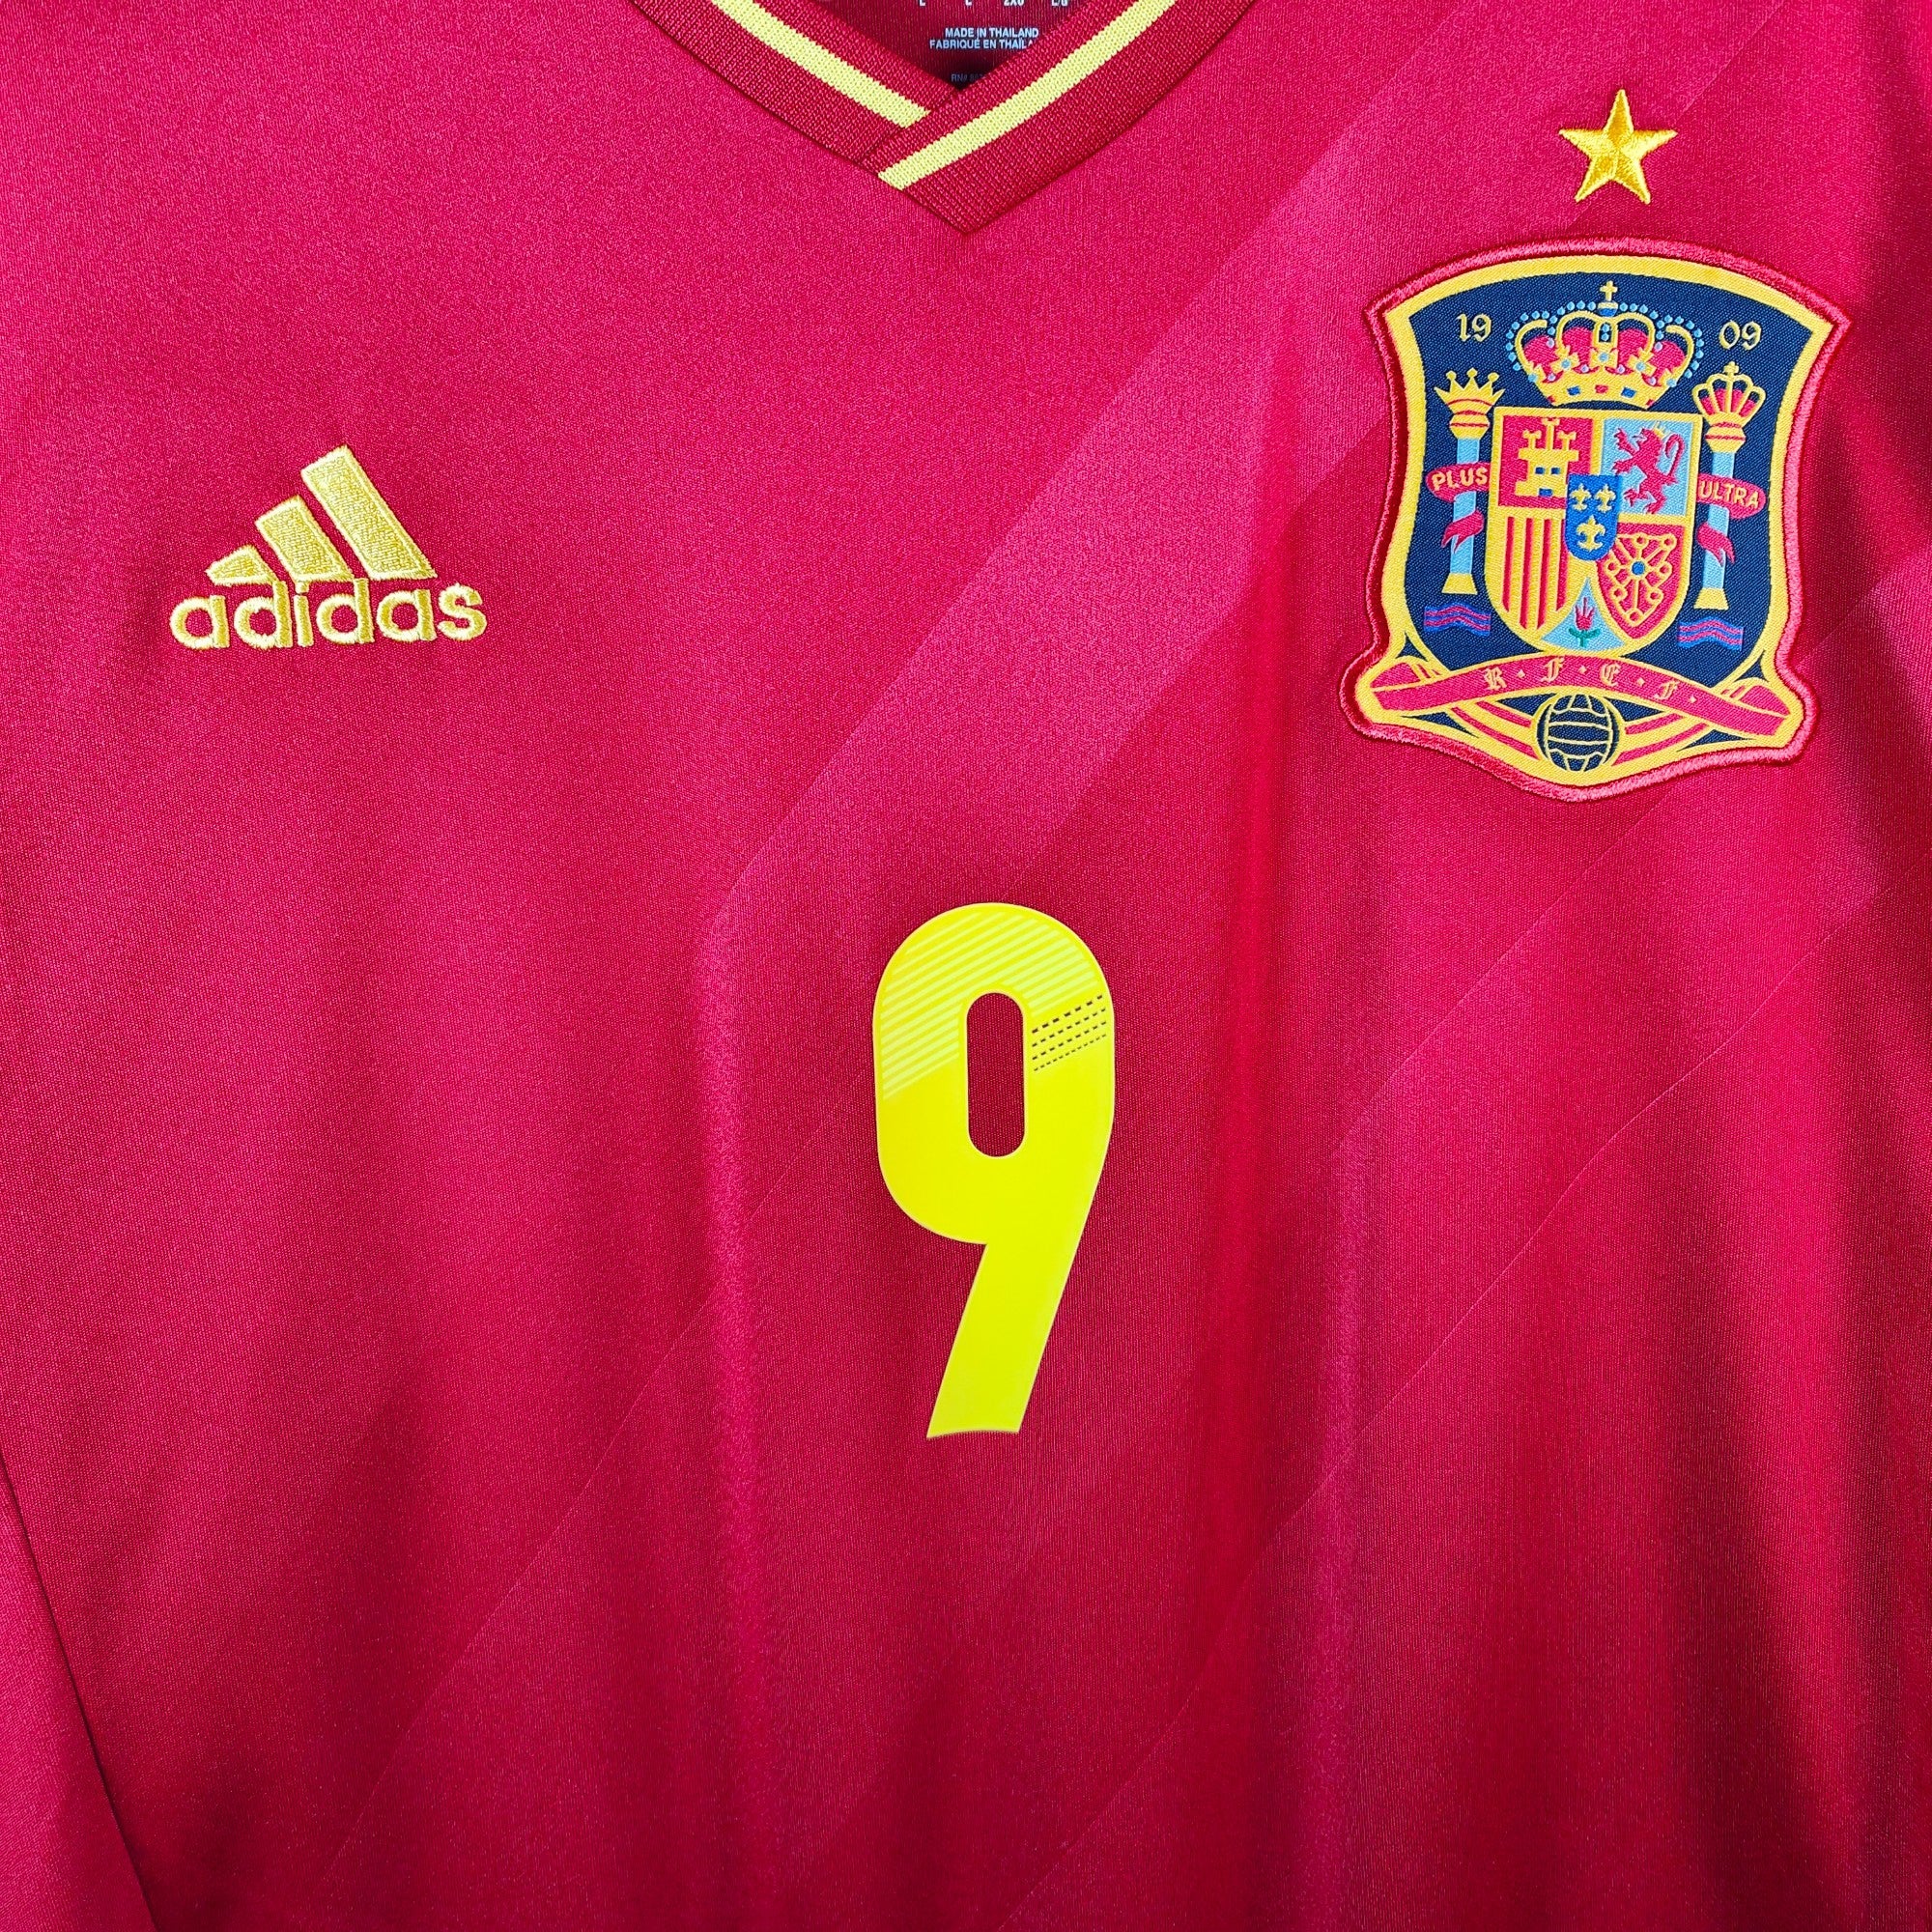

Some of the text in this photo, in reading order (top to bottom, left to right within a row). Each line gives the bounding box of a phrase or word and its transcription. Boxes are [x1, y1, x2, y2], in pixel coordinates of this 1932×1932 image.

[945, 27, 1039, 39] MADE IN THAILAND
[982, 39, 997, 49] EN
[1456, 313, 1762, 351] 19 09
[1432, 467, 1760, 510] PLUS ULTRA
[169, 578, 488, 650] adidas
[872, 902, 1115, 1438] 9
